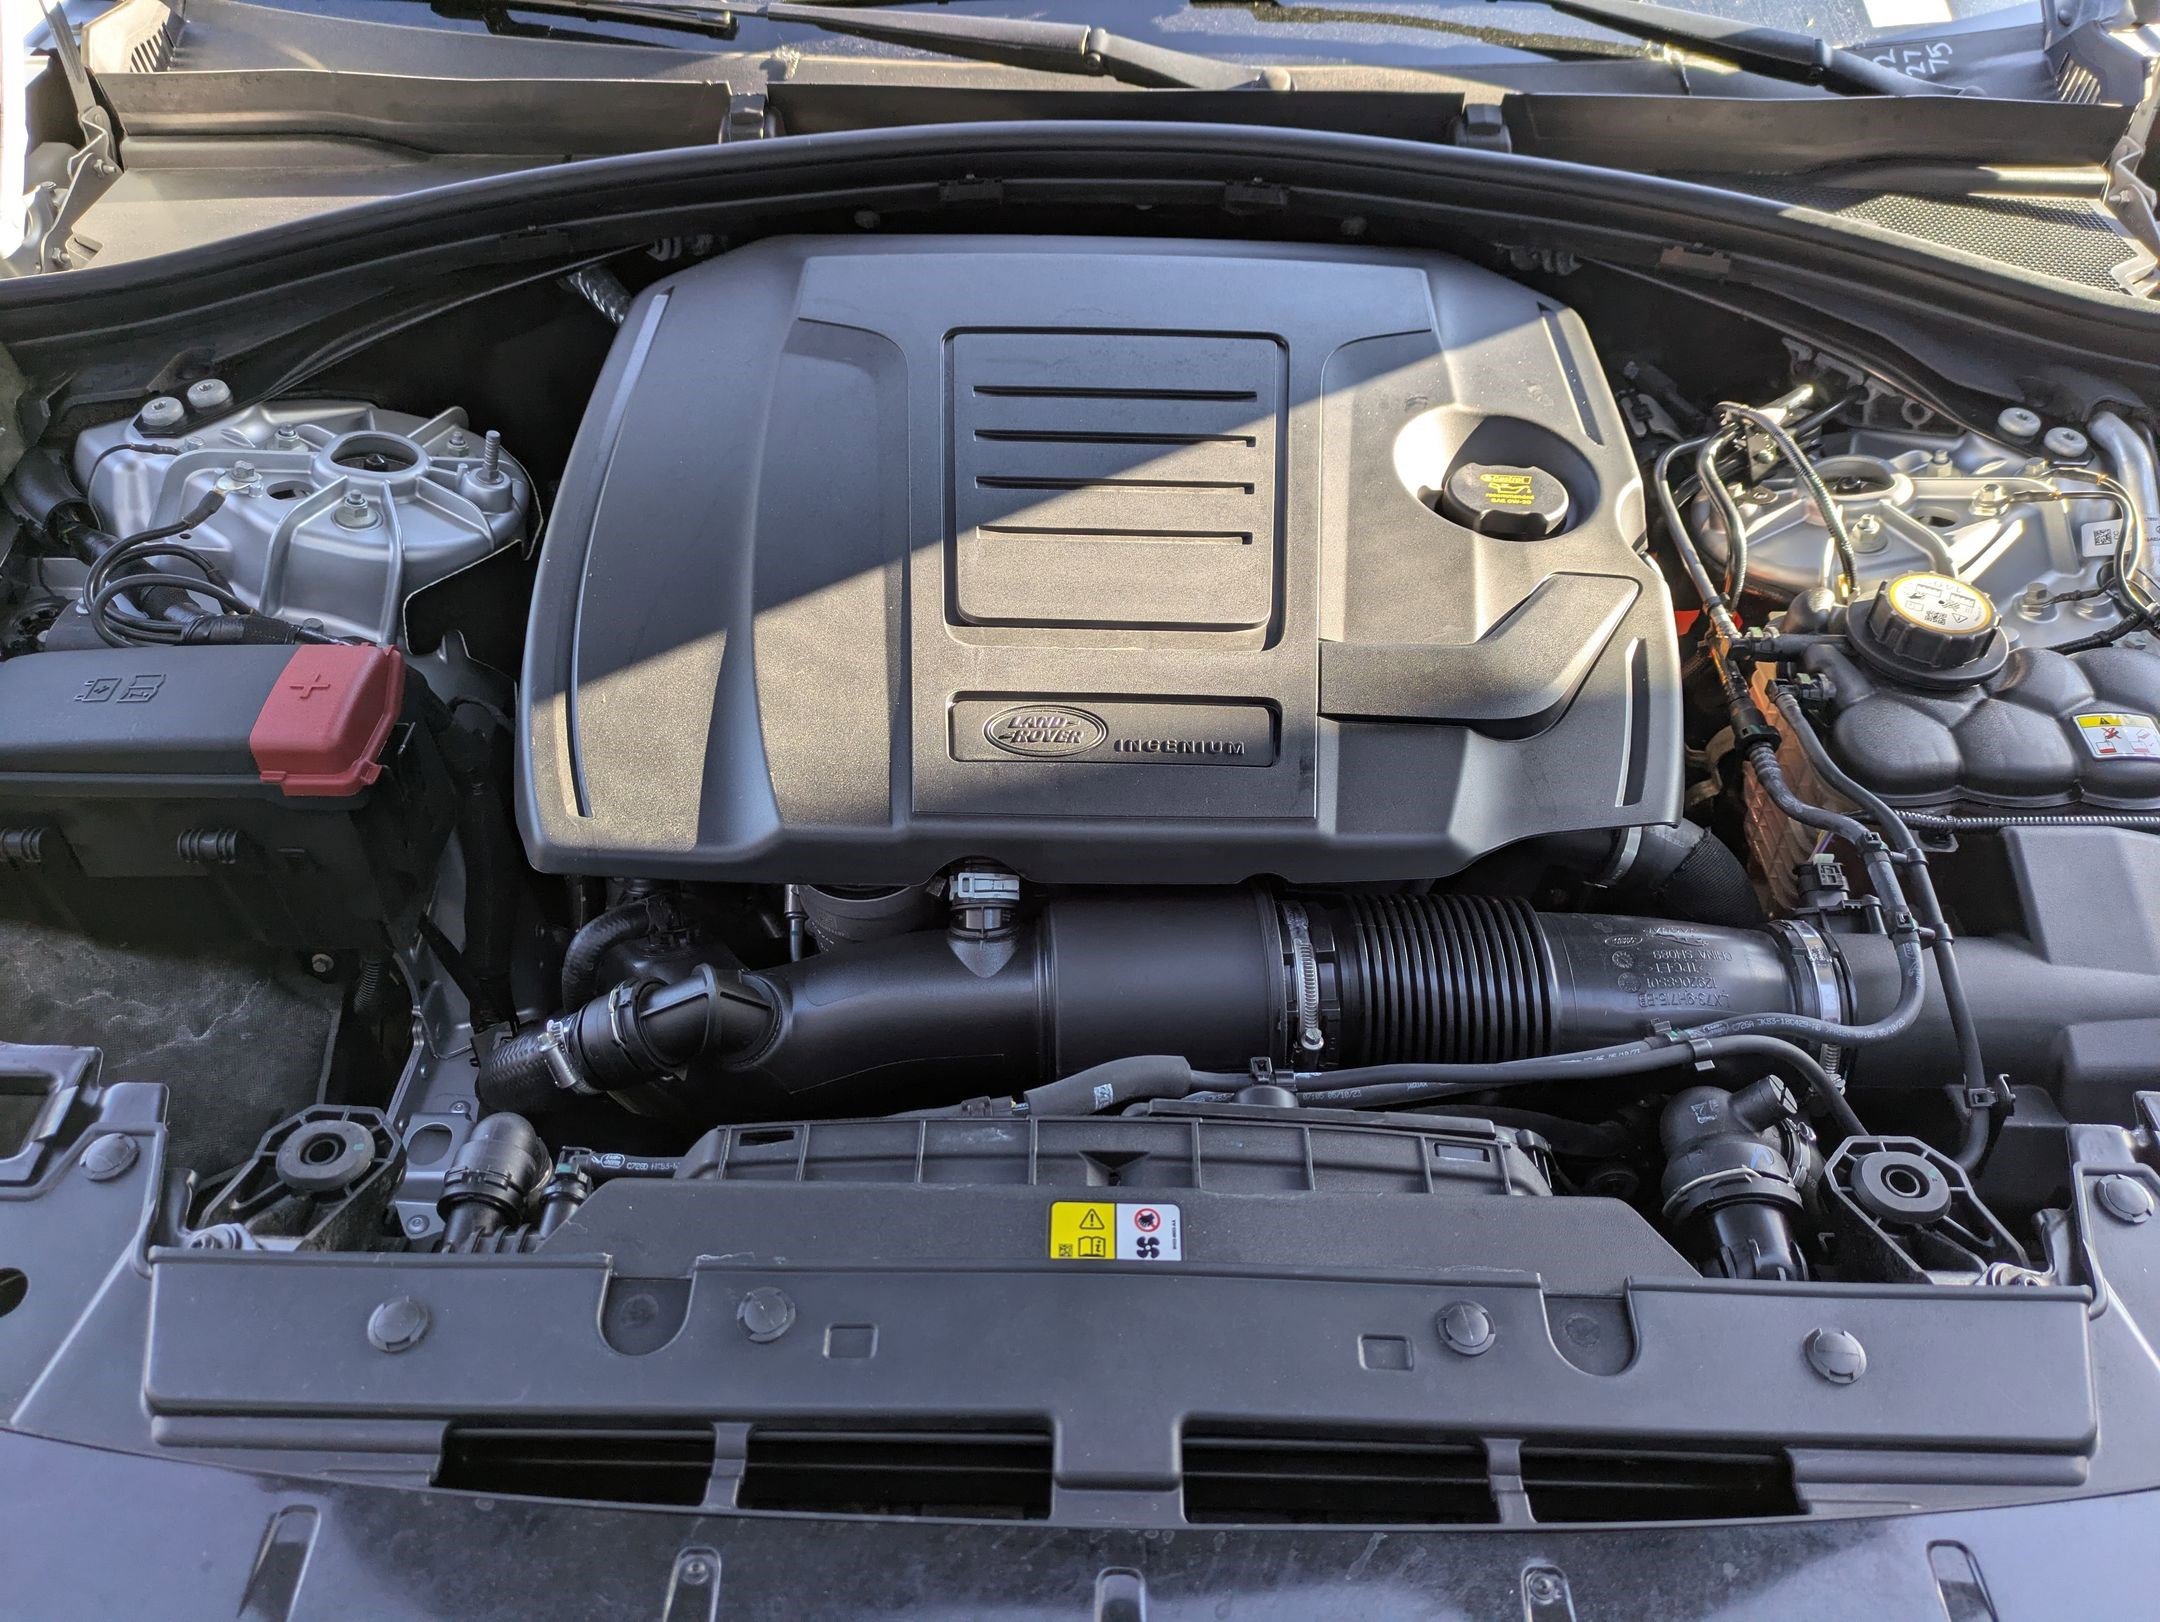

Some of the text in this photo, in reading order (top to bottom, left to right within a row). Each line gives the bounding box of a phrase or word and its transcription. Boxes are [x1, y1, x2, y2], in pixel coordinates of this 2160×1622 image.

[1008, 715, 1067, 729] LAND
[1012, 729, 1085, 744] ROVER
[1114, 738, 1246, 756] INGENIUM
